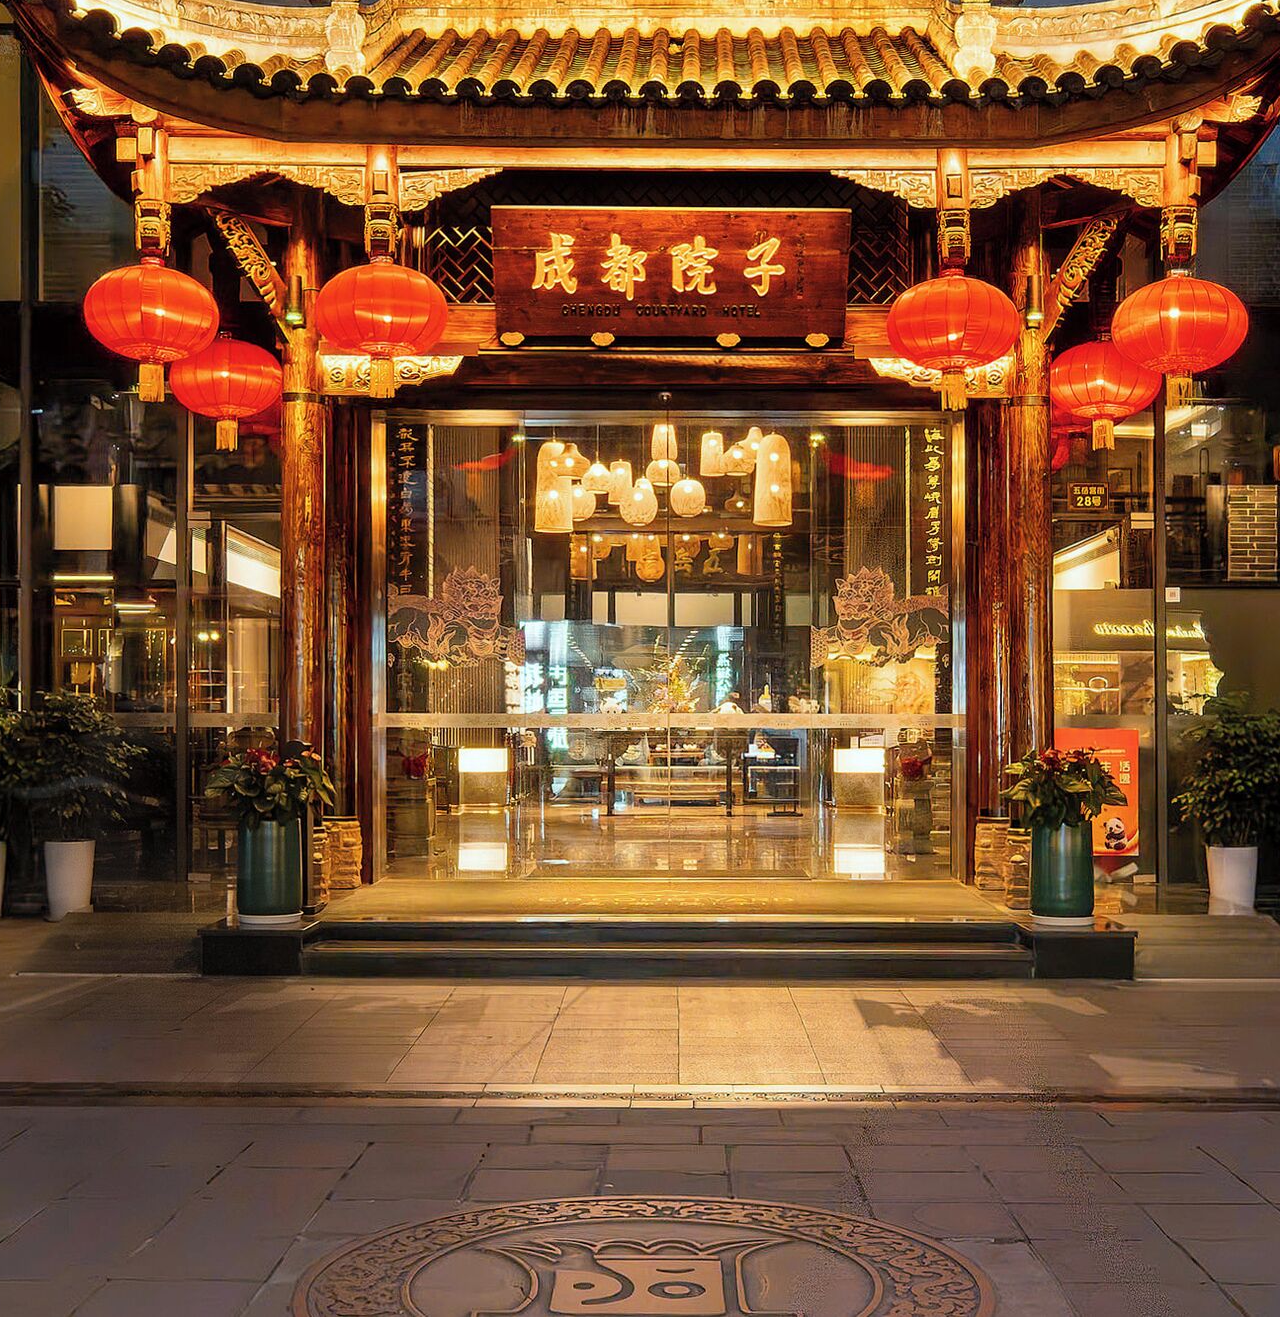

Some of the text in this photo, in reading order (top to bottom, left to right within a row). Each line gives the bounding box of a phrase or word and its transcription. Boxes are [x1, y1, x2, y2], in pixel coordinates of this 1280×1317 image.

[531, 232, 786, 301] 成都院子
[560, 303, 761, 318] CHENGDU COURTYARD HOTEL
